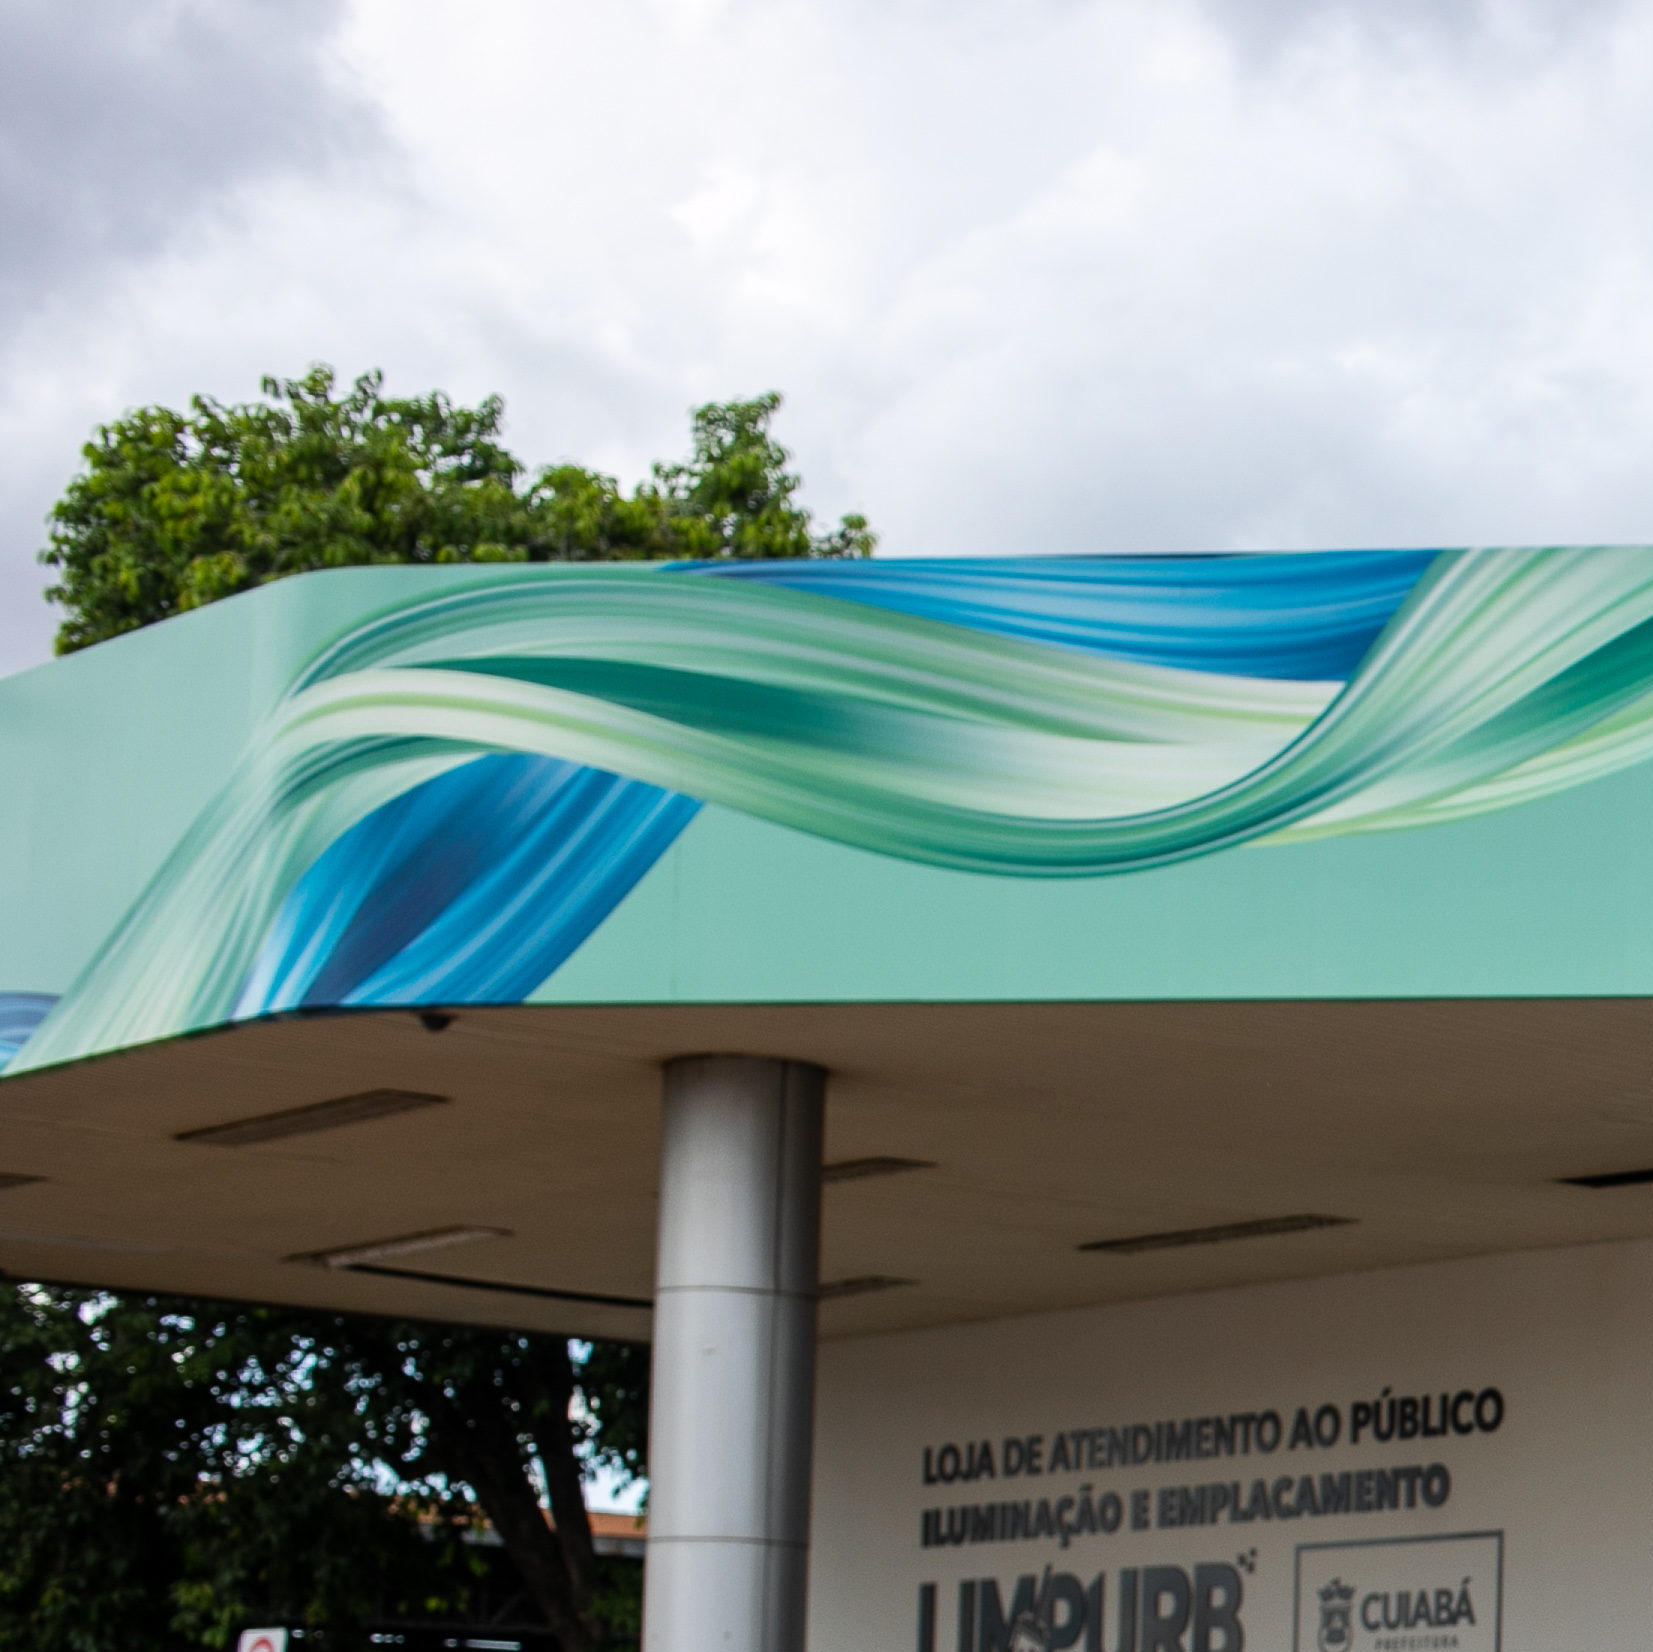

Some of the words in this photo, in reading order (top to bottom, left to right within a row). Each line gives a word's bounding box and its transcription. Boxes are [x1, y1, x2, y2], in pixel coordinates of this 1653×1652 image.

[921, 1438, 996, 1486] LOJA
[1002, 1434, 1044, 1478] DE
[1047, 1410, 1282, 1472] ATENDIMENTO
[1288, 1403, 1341, 1450] AO
[1350, 1386, 1505, 1444] PÚBLICO
[920, 1483, 1123, 1549] ILUMINAÇÃO
[1129, 1489, 1151, 1531] E
[1156, 1462, 1451, 1529] EMPLACAMENTO
[1359, 1576, 1477, 1631] CUIABÁ
[1374, 1632, 1460, 1652] PREFEITURA
